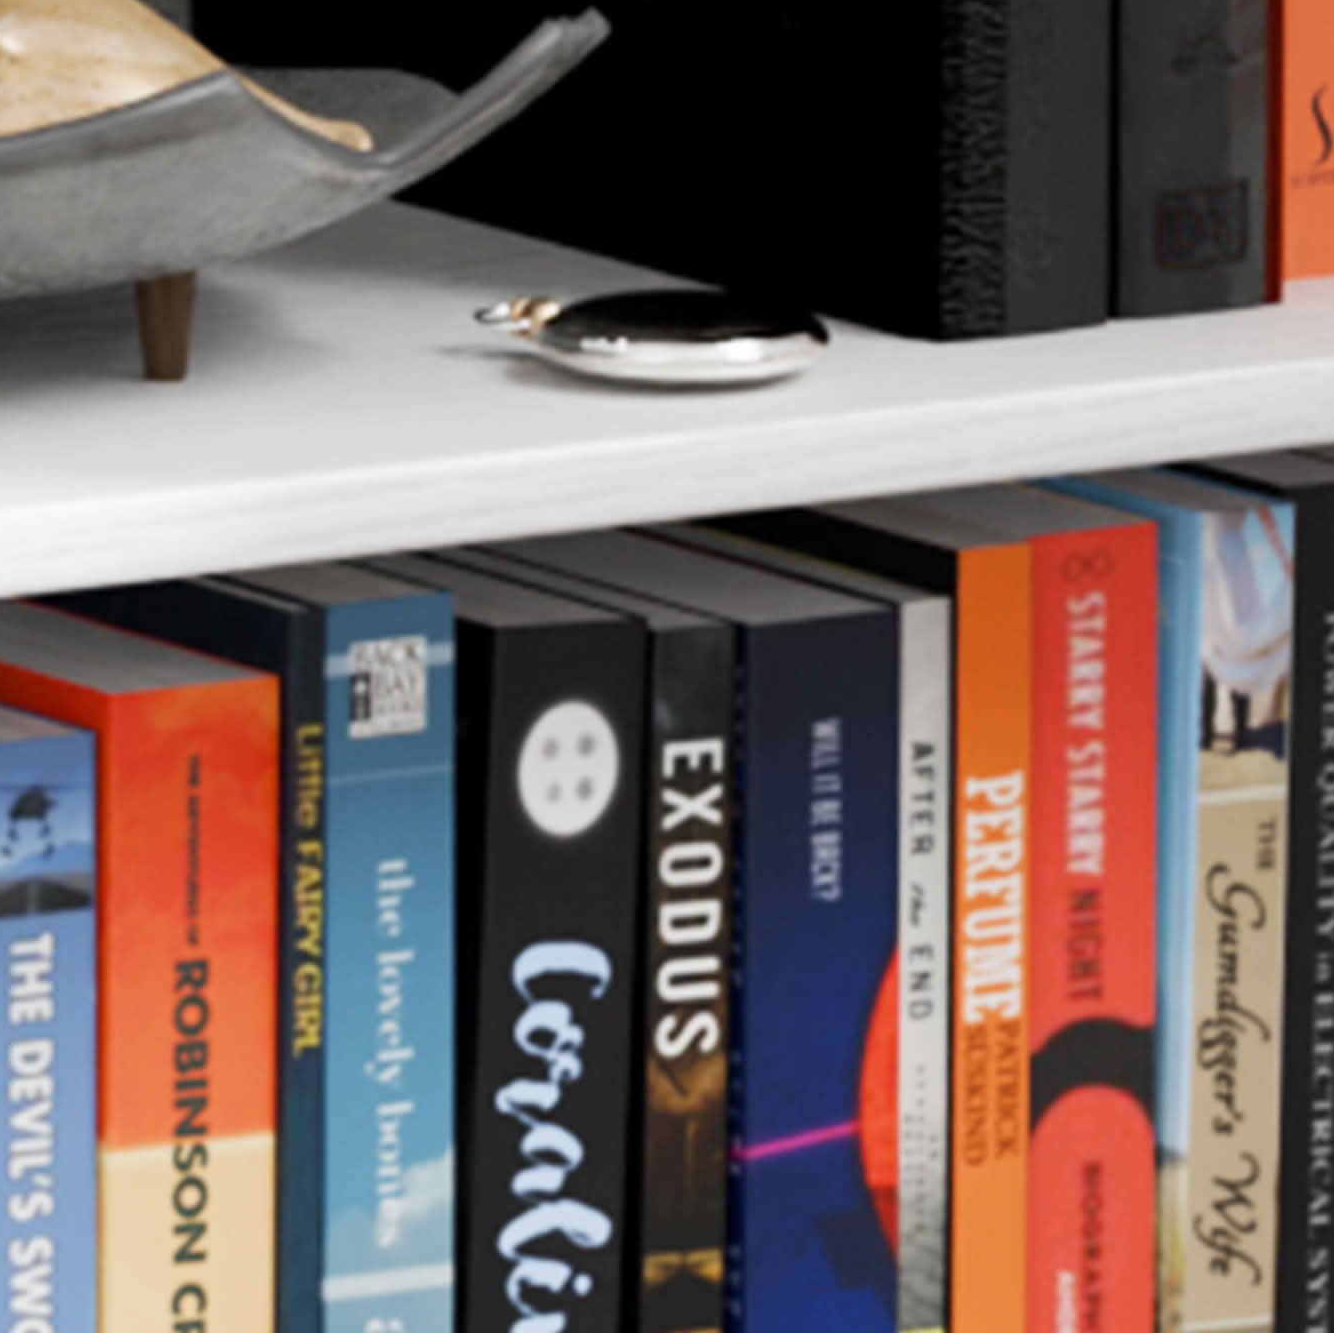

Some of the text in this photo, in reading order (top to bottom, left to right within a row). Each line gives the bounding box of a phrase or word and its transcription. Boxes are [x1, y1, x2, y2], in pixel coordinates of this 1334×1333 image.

[909, 740, 936, 855] AFTER
[1066, 590, 1106, 1003] STARRY STARRY NIGHT
[295, 840, 323, 957] FAIRY
[653, 737, 724, 1060] EXODUS
[963, 770, 1024, 1025] PERFUME
[8, 931, 55, 1025] THE
[293, 962, 323, 1057] GIRL
[908, 943, 934, 1022] END
[171, 957, 210, 1267] ROBINSON
[364, 858, 416, 1249] the lovely bones
[995, 1021, 1019, 1160] PATRICK
[7, 1038, 55, 1224] DEVIL'S
[1194, 1151, 1265, 1288] Wife
